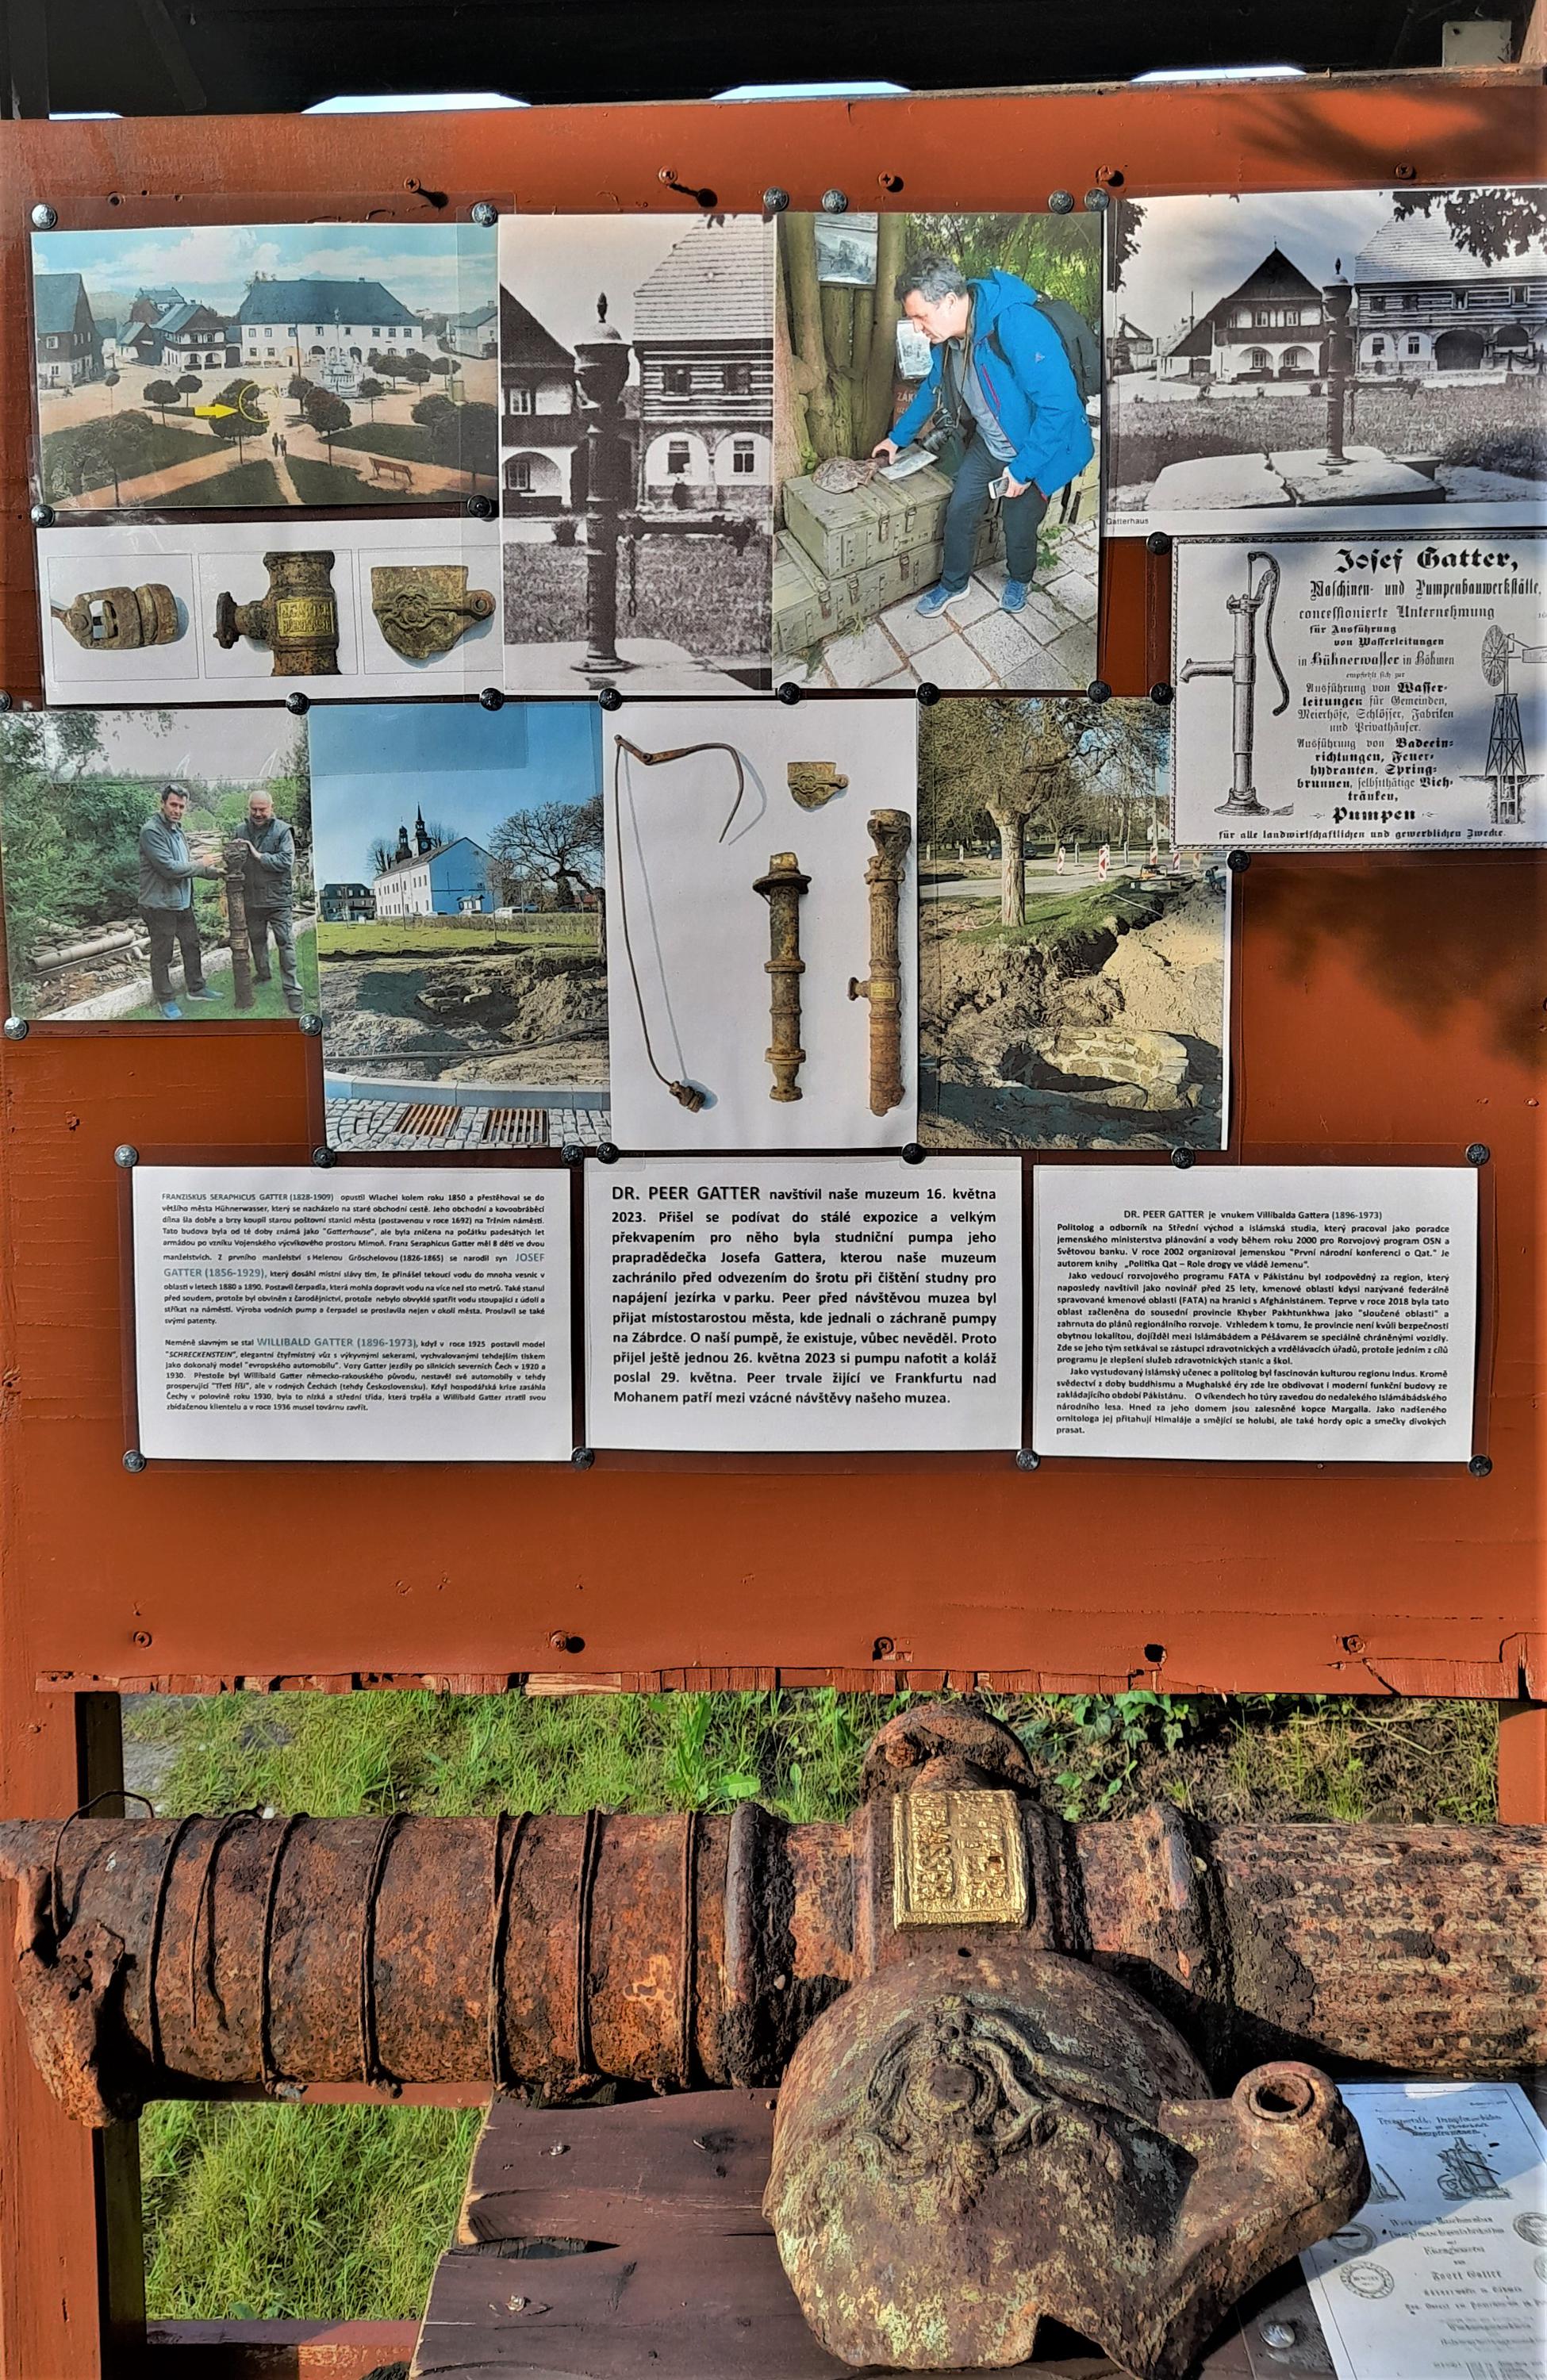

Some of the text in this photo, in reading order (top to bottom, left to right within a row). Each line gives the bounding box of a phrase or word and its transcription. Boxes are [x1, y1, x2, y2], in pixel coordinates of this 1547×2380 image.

[1335, 548, 1403, 575] Josef
[1298, 656, 1307, 666] in
[1403, 654, 1411, 665] in
[612, 1186, 996, 1200] DR. PEER GATTER navštívil naše muzeum 16. května
[612, 1211, 996, 1225] 2023. Přišel se podívat do stálé expozice a velkým
[1208, 1211, 1219, 1221] je
[1332, 1211, 1382, 1220] (1896-1973)
[612, 1231, 996, 1246] překvapením pro něho byla studniční pumpa jeho
[516, 1253, 545, 1262] JOSEF
[612, 1251, 996, 1265] prapradědečka Josefa Gattera, kterou naše muzeum
[164, 1265, 269, 1280] GATTER (1856-1929),
[612, 1271, 996, 1286] zachránilo před odvezením do šrotu při čištění studny pro
[612, 1292, 667, 1306] napájení
[674, 1292, 716, 1305] jezírka
[735, 1292, 774, 1306] parku.
[782, 1292, 811, 1303] Peer
[819, 1292, 847, 1307] před
[855, 1292, 920, 1303] návštěvou
[928, 1295, 969, 1303] muzea
[978, 1292, 996, 1306] byl
[613, 1311, 646, 1326] přijat
[652, 1311, 746, 1323] místostarostou
[752, 1311, 794, 1325] města,
[800, 1311, 823, 1323] kde
[827, 1312, 871, 1326] jednali
[889, 1312, 946, 1324] záchraně
[952, 1315, 996, 1326] pumpy
[257, 1338, 420, 1350] WILLIBALD GATTER (1896-1973),
[632, 1331, 685, 1343] Zábrdce.
[690, 1332, 701, 1343] O
[705, 1331, 730, 1343] naší
[734, 1332, 782, 1345] pumpě,
[786, 1332, 800, 1343] že
[804, 1332, 857, 1345] existuje,
[861, 1331, 899, 1344] vůbec
[903, 1332, 957, 1344] nevěděl.
[962, 1333, 996, 1344] Proto
[613, 1351, 645, 1365] přijel
[649, 1352, 680, 1365] ještě
[684, 1352, 728, 1365] jednou
[734, 1352, 752, 1363] 26.
[758, 1352, 800, 1363] května
[805, 1353, 835, 1363] 2023
[840, 1353, 850, 1364] si
[854, 1355, 900, 1366] pumpu
[904, 1352, 947, 1364] nafotit
[964, 1353, 996, 1364] koláž
[614, 1372, 650, 1384] poslal
[661, 1372, 679, 1383] 29.
[690, 1372, 736, 1383] května.
[747, 1372, 776, 1383] Peer
[785, 1372, 822, 1384] trvale
[833, 1372, 861, 1386] žijící
[896, 1372, 962, 1384] Frankfurtu
[973, 1372, 996, 1384] nad
[614, 1391, 950, 1406] Mohanem patří mezi vzácné návštěvy našeho muzea.
